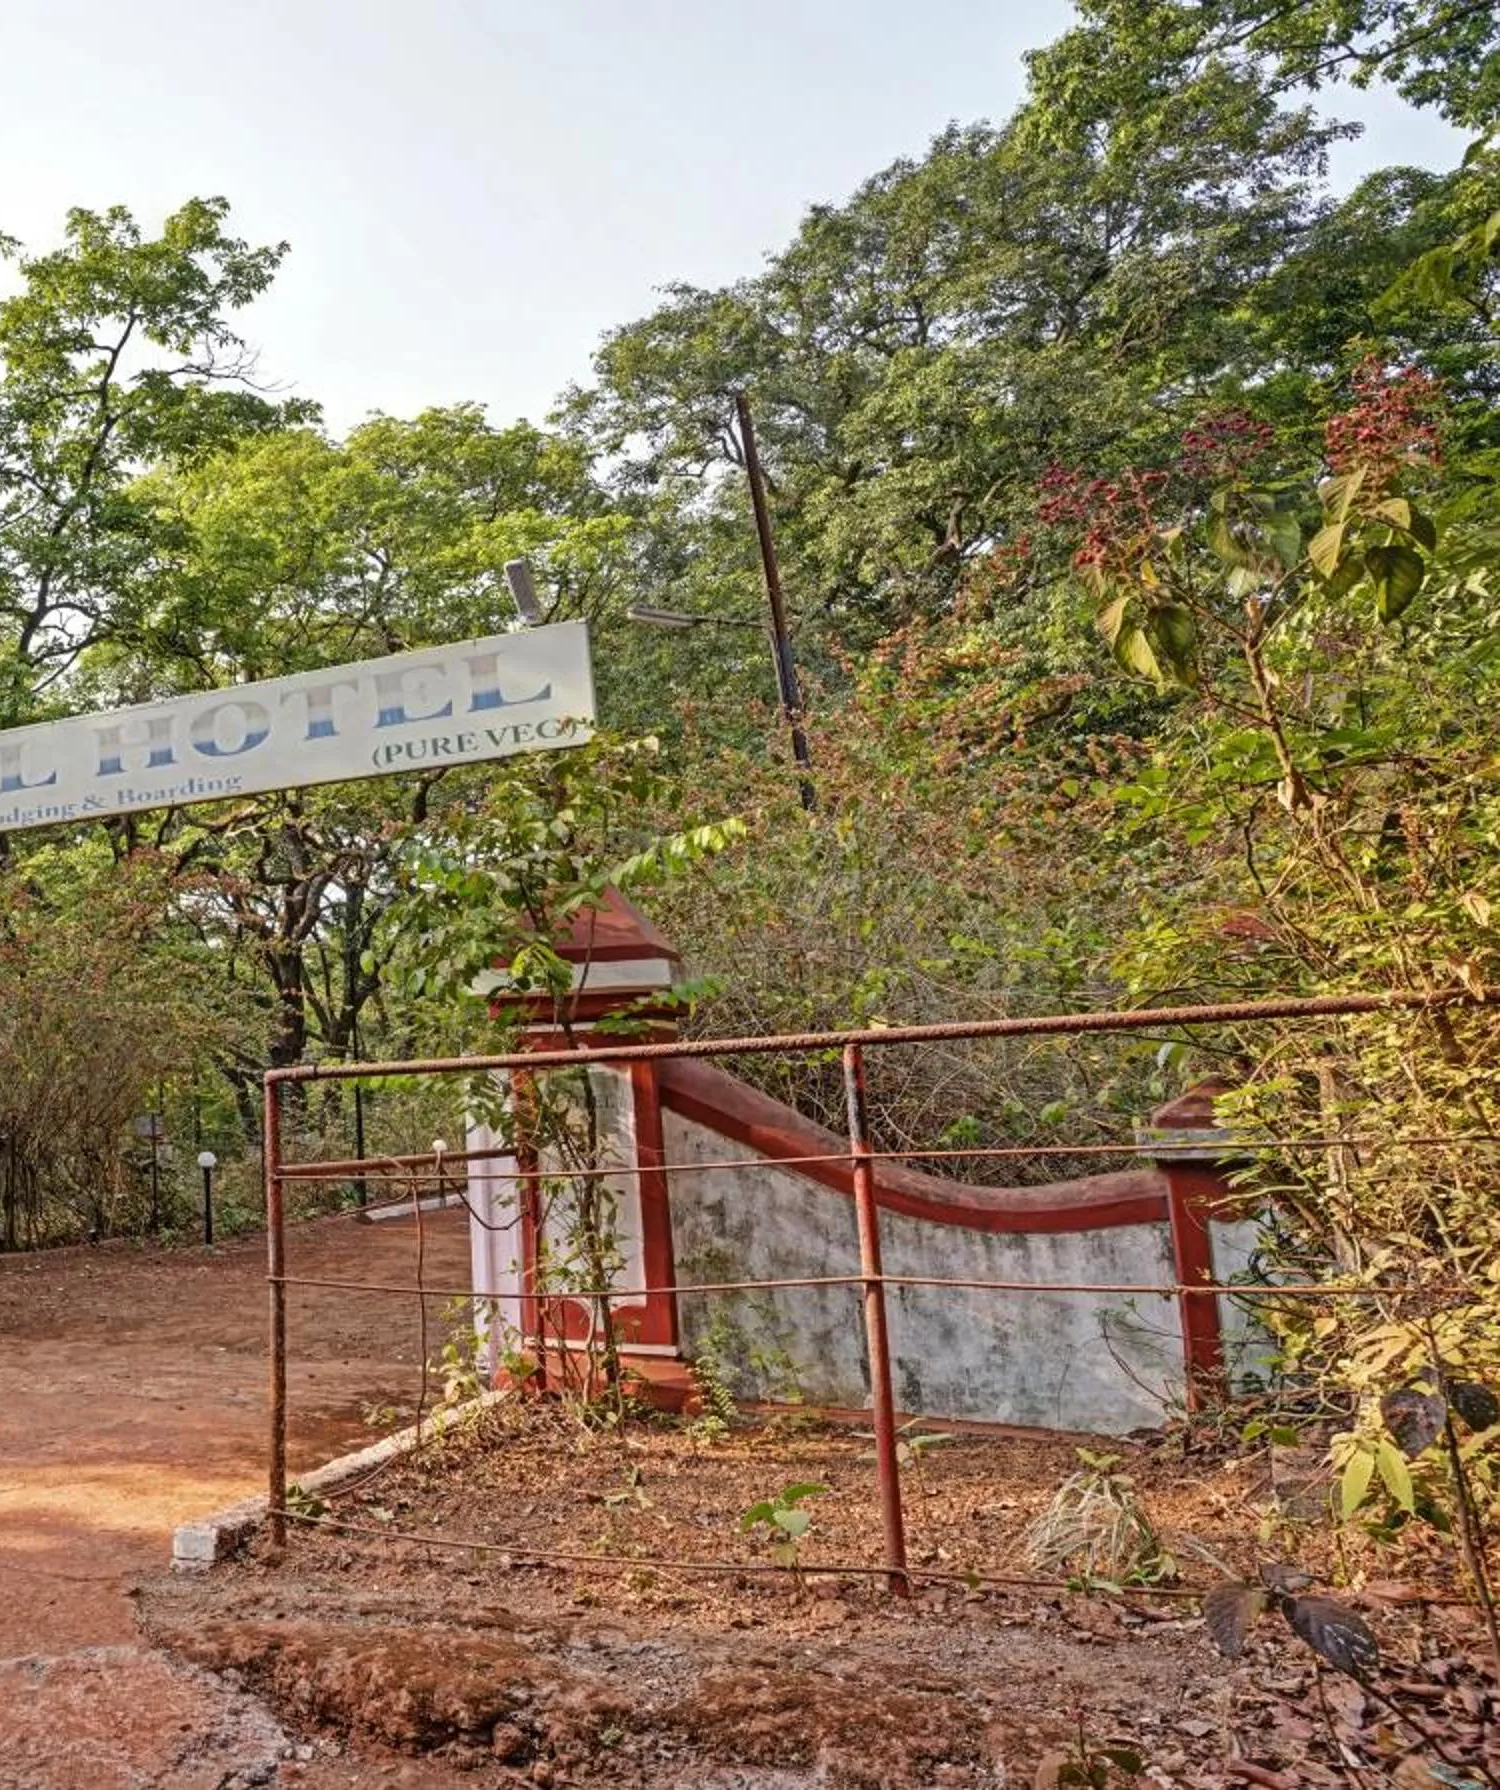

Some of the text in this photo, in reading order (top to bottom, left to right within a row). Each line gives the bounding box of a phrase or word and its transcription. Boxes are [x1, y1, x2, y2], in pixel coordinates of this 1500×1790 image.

[94, 652, 551, 777] HOTEL
[372, 718, 577, 768] (PURE VEG)
[82, 795, 106, 811] &
[117, 774, 243, 805] Boarding
